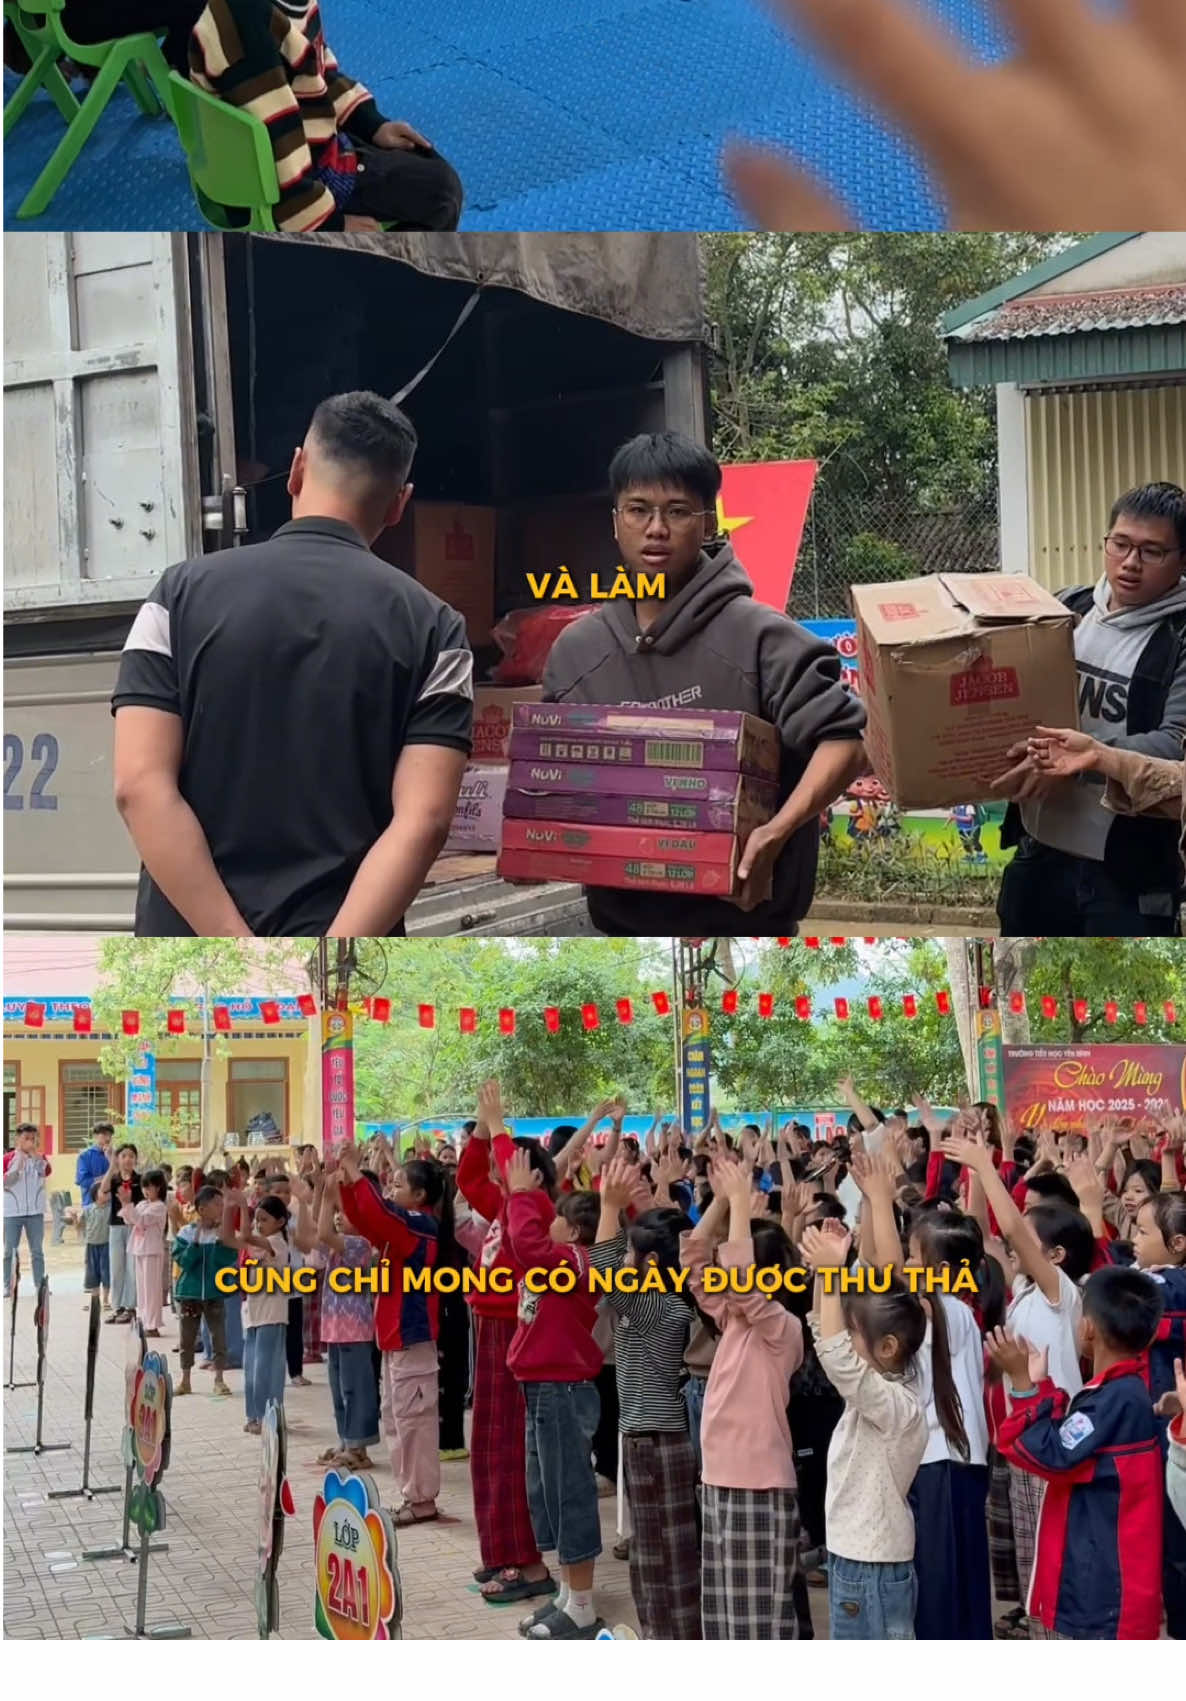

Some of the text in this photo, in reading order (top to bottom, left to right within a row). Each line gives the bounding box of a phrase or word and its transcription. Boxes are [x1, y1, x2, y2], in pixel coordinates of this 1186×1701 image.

[1077, 674, 1128, 724] NS
[1053, 1060, 1106, 1089] Chào
[1048, 1097, 1075, 1112] NĂM
[1078, 1099, 1105, 1115] HỌC
[1108, 1098, 1135, 1112] 2025
[334, 1518, 361, 1552] LỚP
[327, 1552, 370, 1628] 2A1
